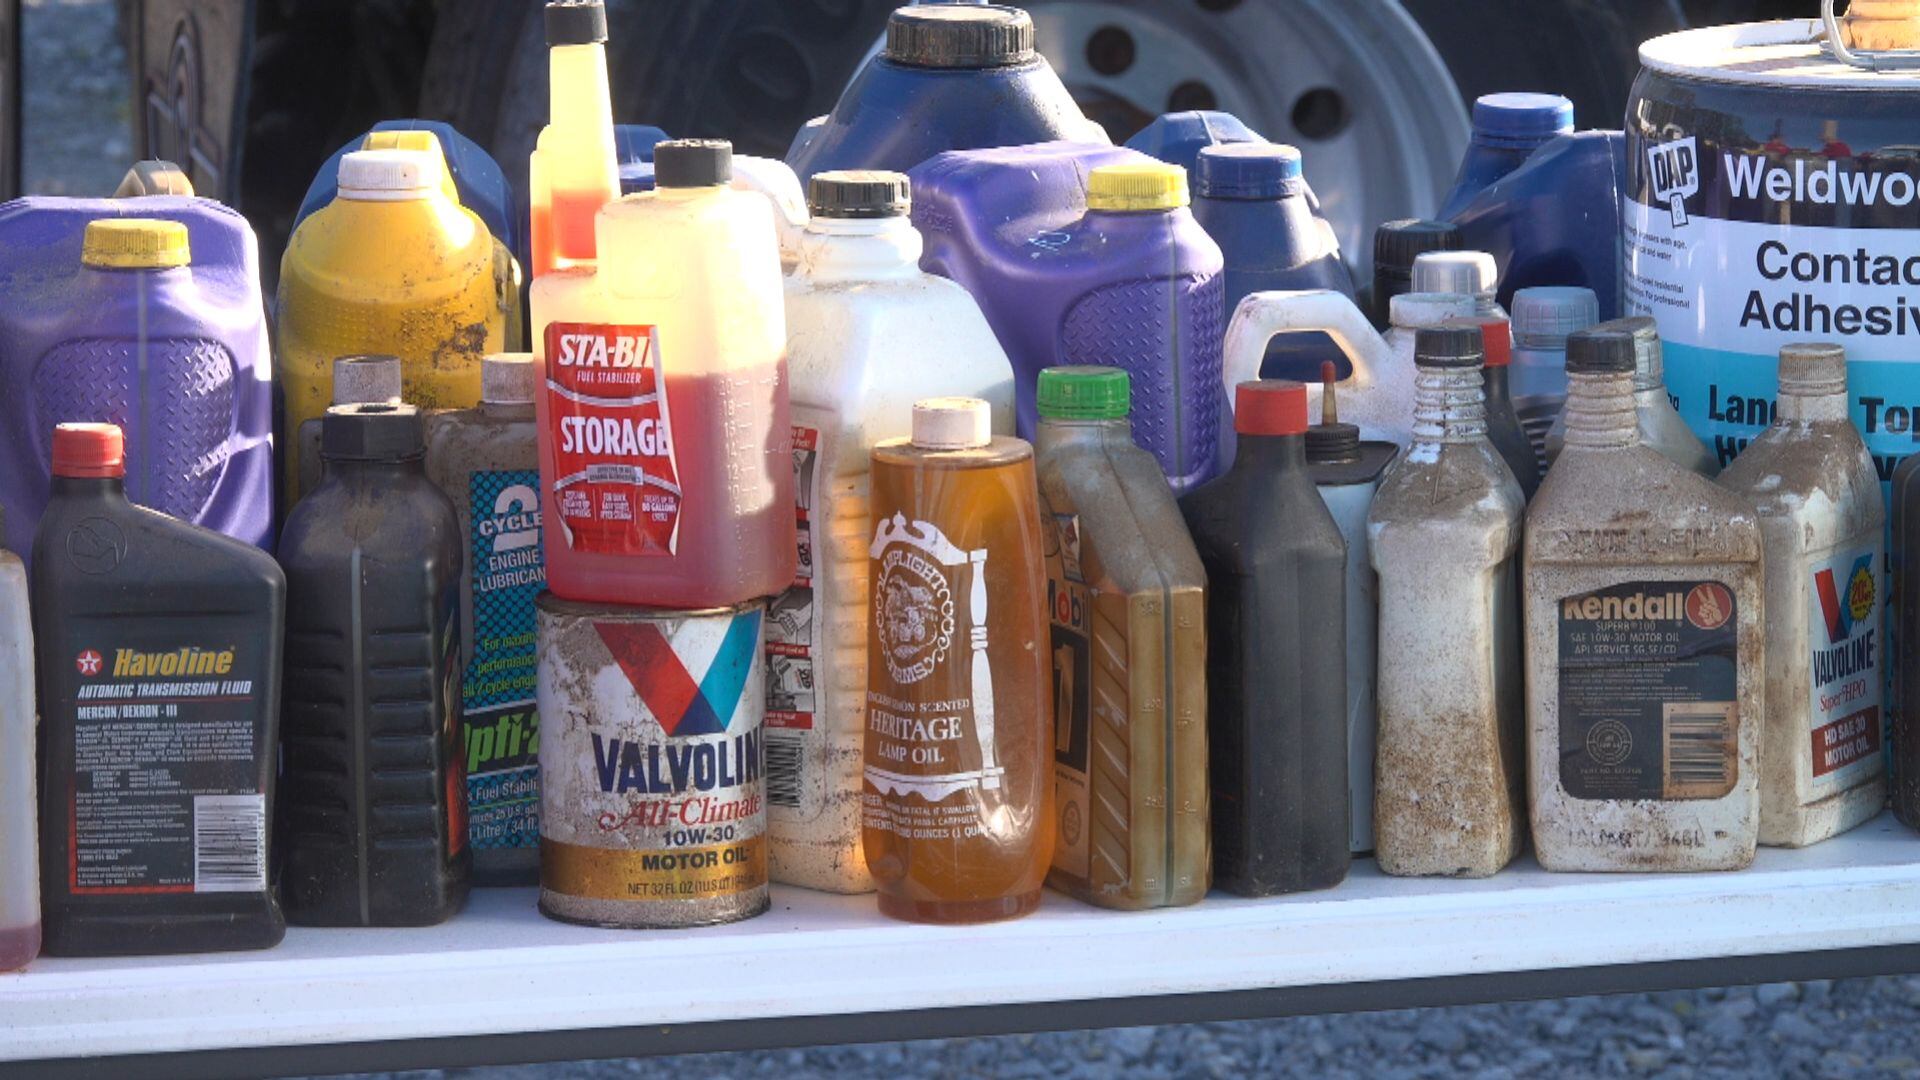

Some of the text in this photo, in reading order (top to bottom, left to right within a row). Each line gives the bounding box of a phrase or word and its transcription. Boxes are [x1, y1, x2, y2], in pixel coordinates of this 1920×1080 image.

[1653, 146, 1693, 193] DAP
[1724, 154, 1920, 207] Weldwo
[1756, 240, 1920, 286] Contac
[577, 370, 641, 384] FUEL STABILIZER
[561, 416, 670, 456] STORAGE
[479, 512, 543, 536] CYCLE
[494, 484, 538, 552] 2
[489, 549, 540, 571] ENGINE
[1564, 592, 1683, 620] Kendall
[1570, 633, 1680, 642] SAE 10W-30 MOTOR OIL
[1640, 621, 1656, 631] 100
[1575, 645, 1590, 654] API
[1594, 645, 1630, 654] SERVICE
[1813, 628, 1875, 689] VALVOLINE
[113, 648, 234, 677] Havoline
[78, 680, 252, 699] AUTOMATIC TRANSMISSION FLUID
[870, 709, 963, 741] HERITAGE
[1824, 715, 1866, 747] HD SAE 30
[878, 741, 907, 762] LAMP
[1824, 736, 1869, 768] MOTOR OIL
[476, 785, 499, 801] Fuel
[599, 795, 761, 831] All-Climate
[477, 825, 500, 840] Litre
[663, 825, 735, 847] 10W-30
[914, 828, 949, 838] OUNCES
[641, 846, 749, 870] MOTOR OIL
[628, 883, 648, 896] NET
